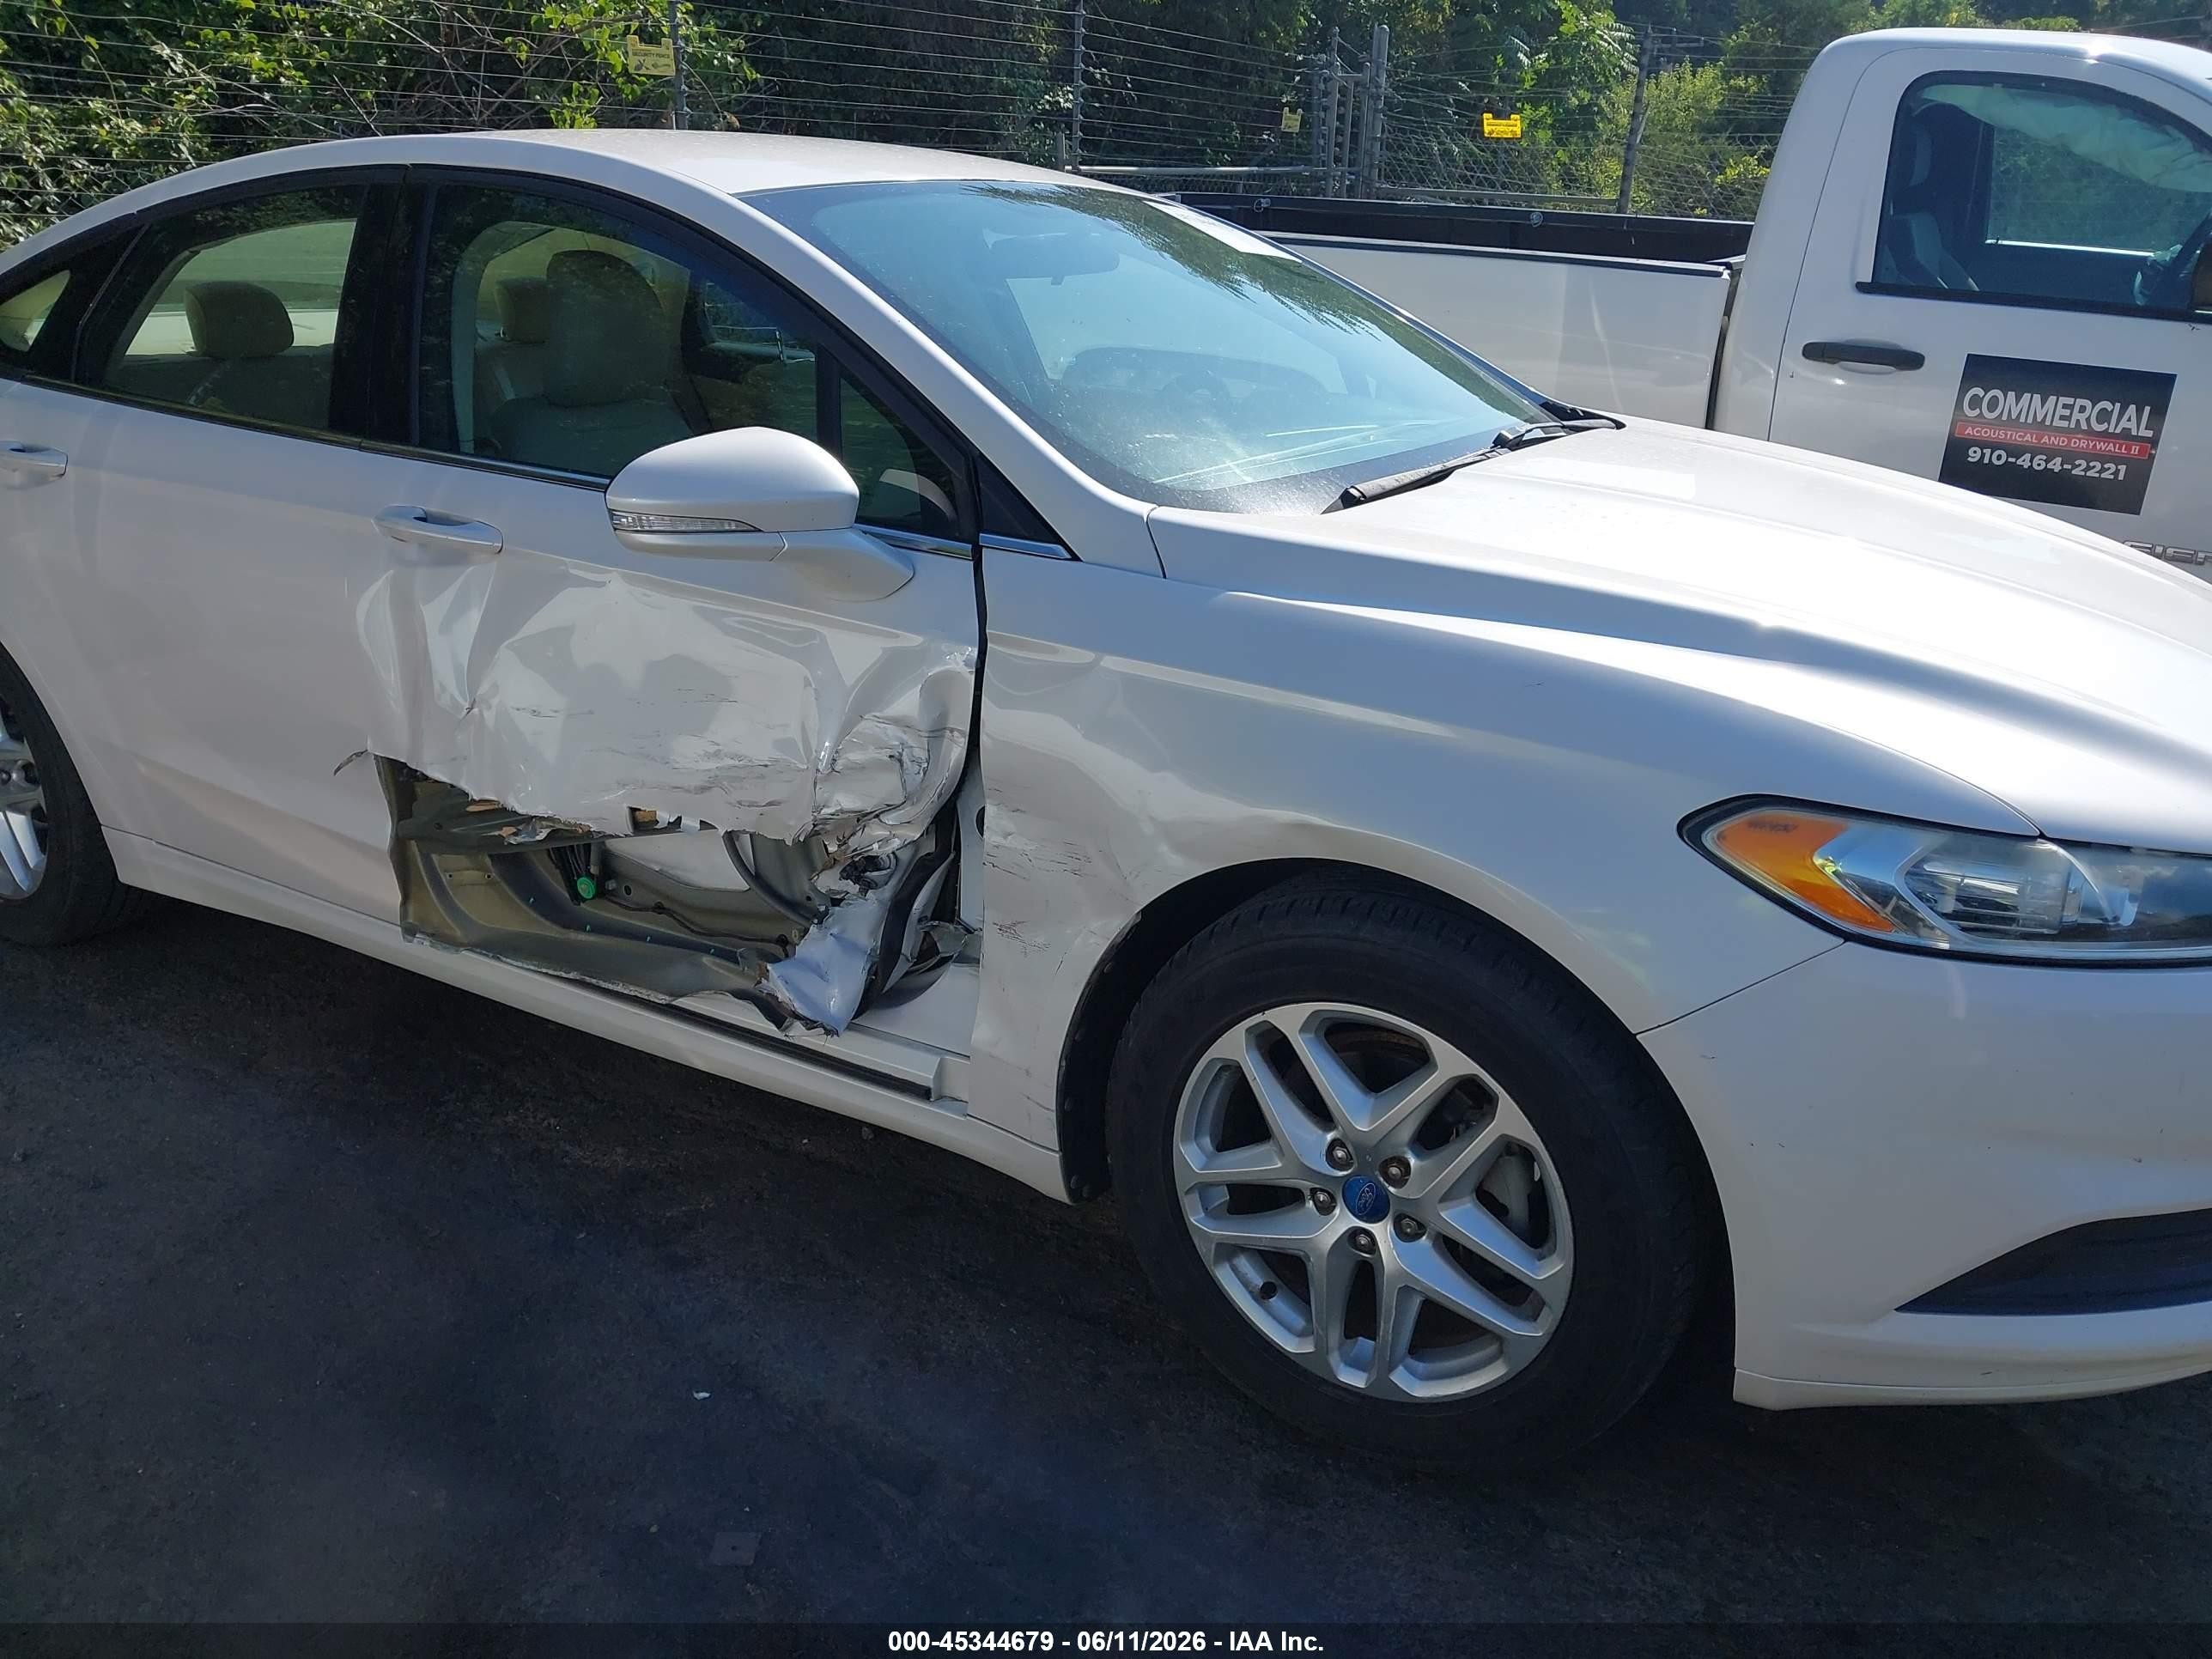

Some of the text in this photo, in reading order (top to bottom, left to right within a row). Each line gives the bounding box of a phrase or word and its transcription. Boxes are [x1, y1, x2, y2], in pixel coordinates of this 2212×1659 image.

[1963, 387, 2154, 437] COMMERCIAL
[1965, 426, 2141, 455] ACOUSTICAL AND DRYWALL II
[1966, 447, 2127, 480] 910-464-2221
